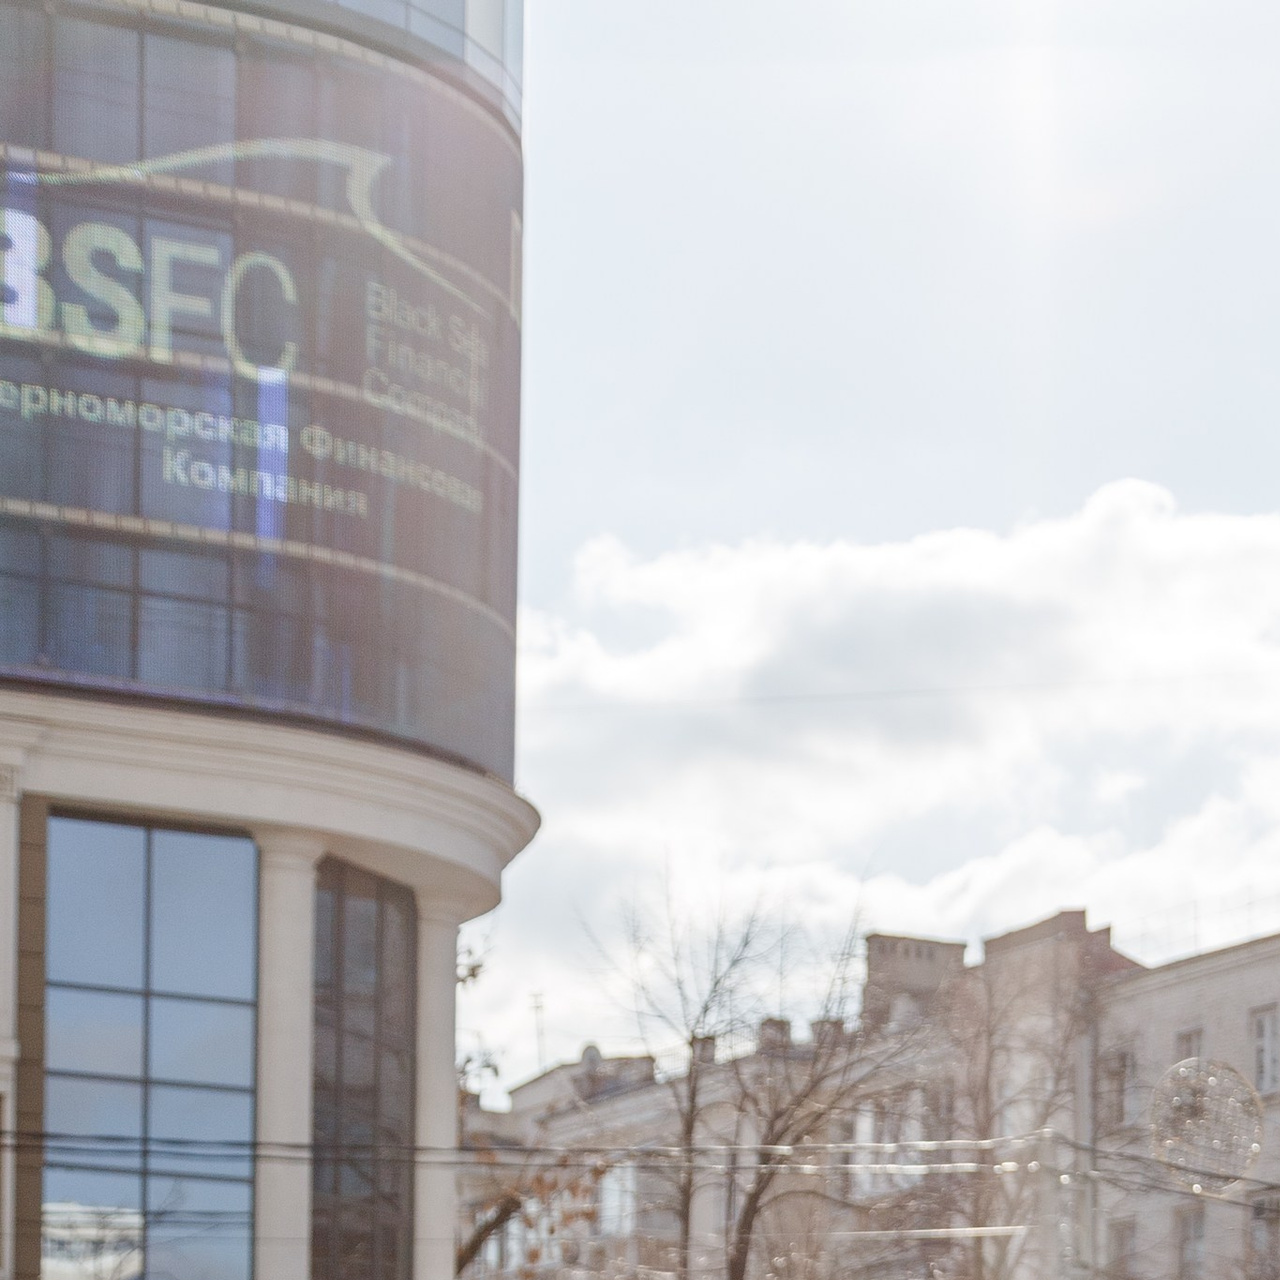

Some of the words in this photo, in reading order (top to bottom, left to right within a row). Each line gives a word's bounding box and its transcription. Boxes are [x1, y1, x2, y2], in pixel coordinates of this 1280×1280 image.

[0, 207, 298, 386] BSFC
[366, 280, 442, 340] Black
[162, 445, 368, 520] Компания
